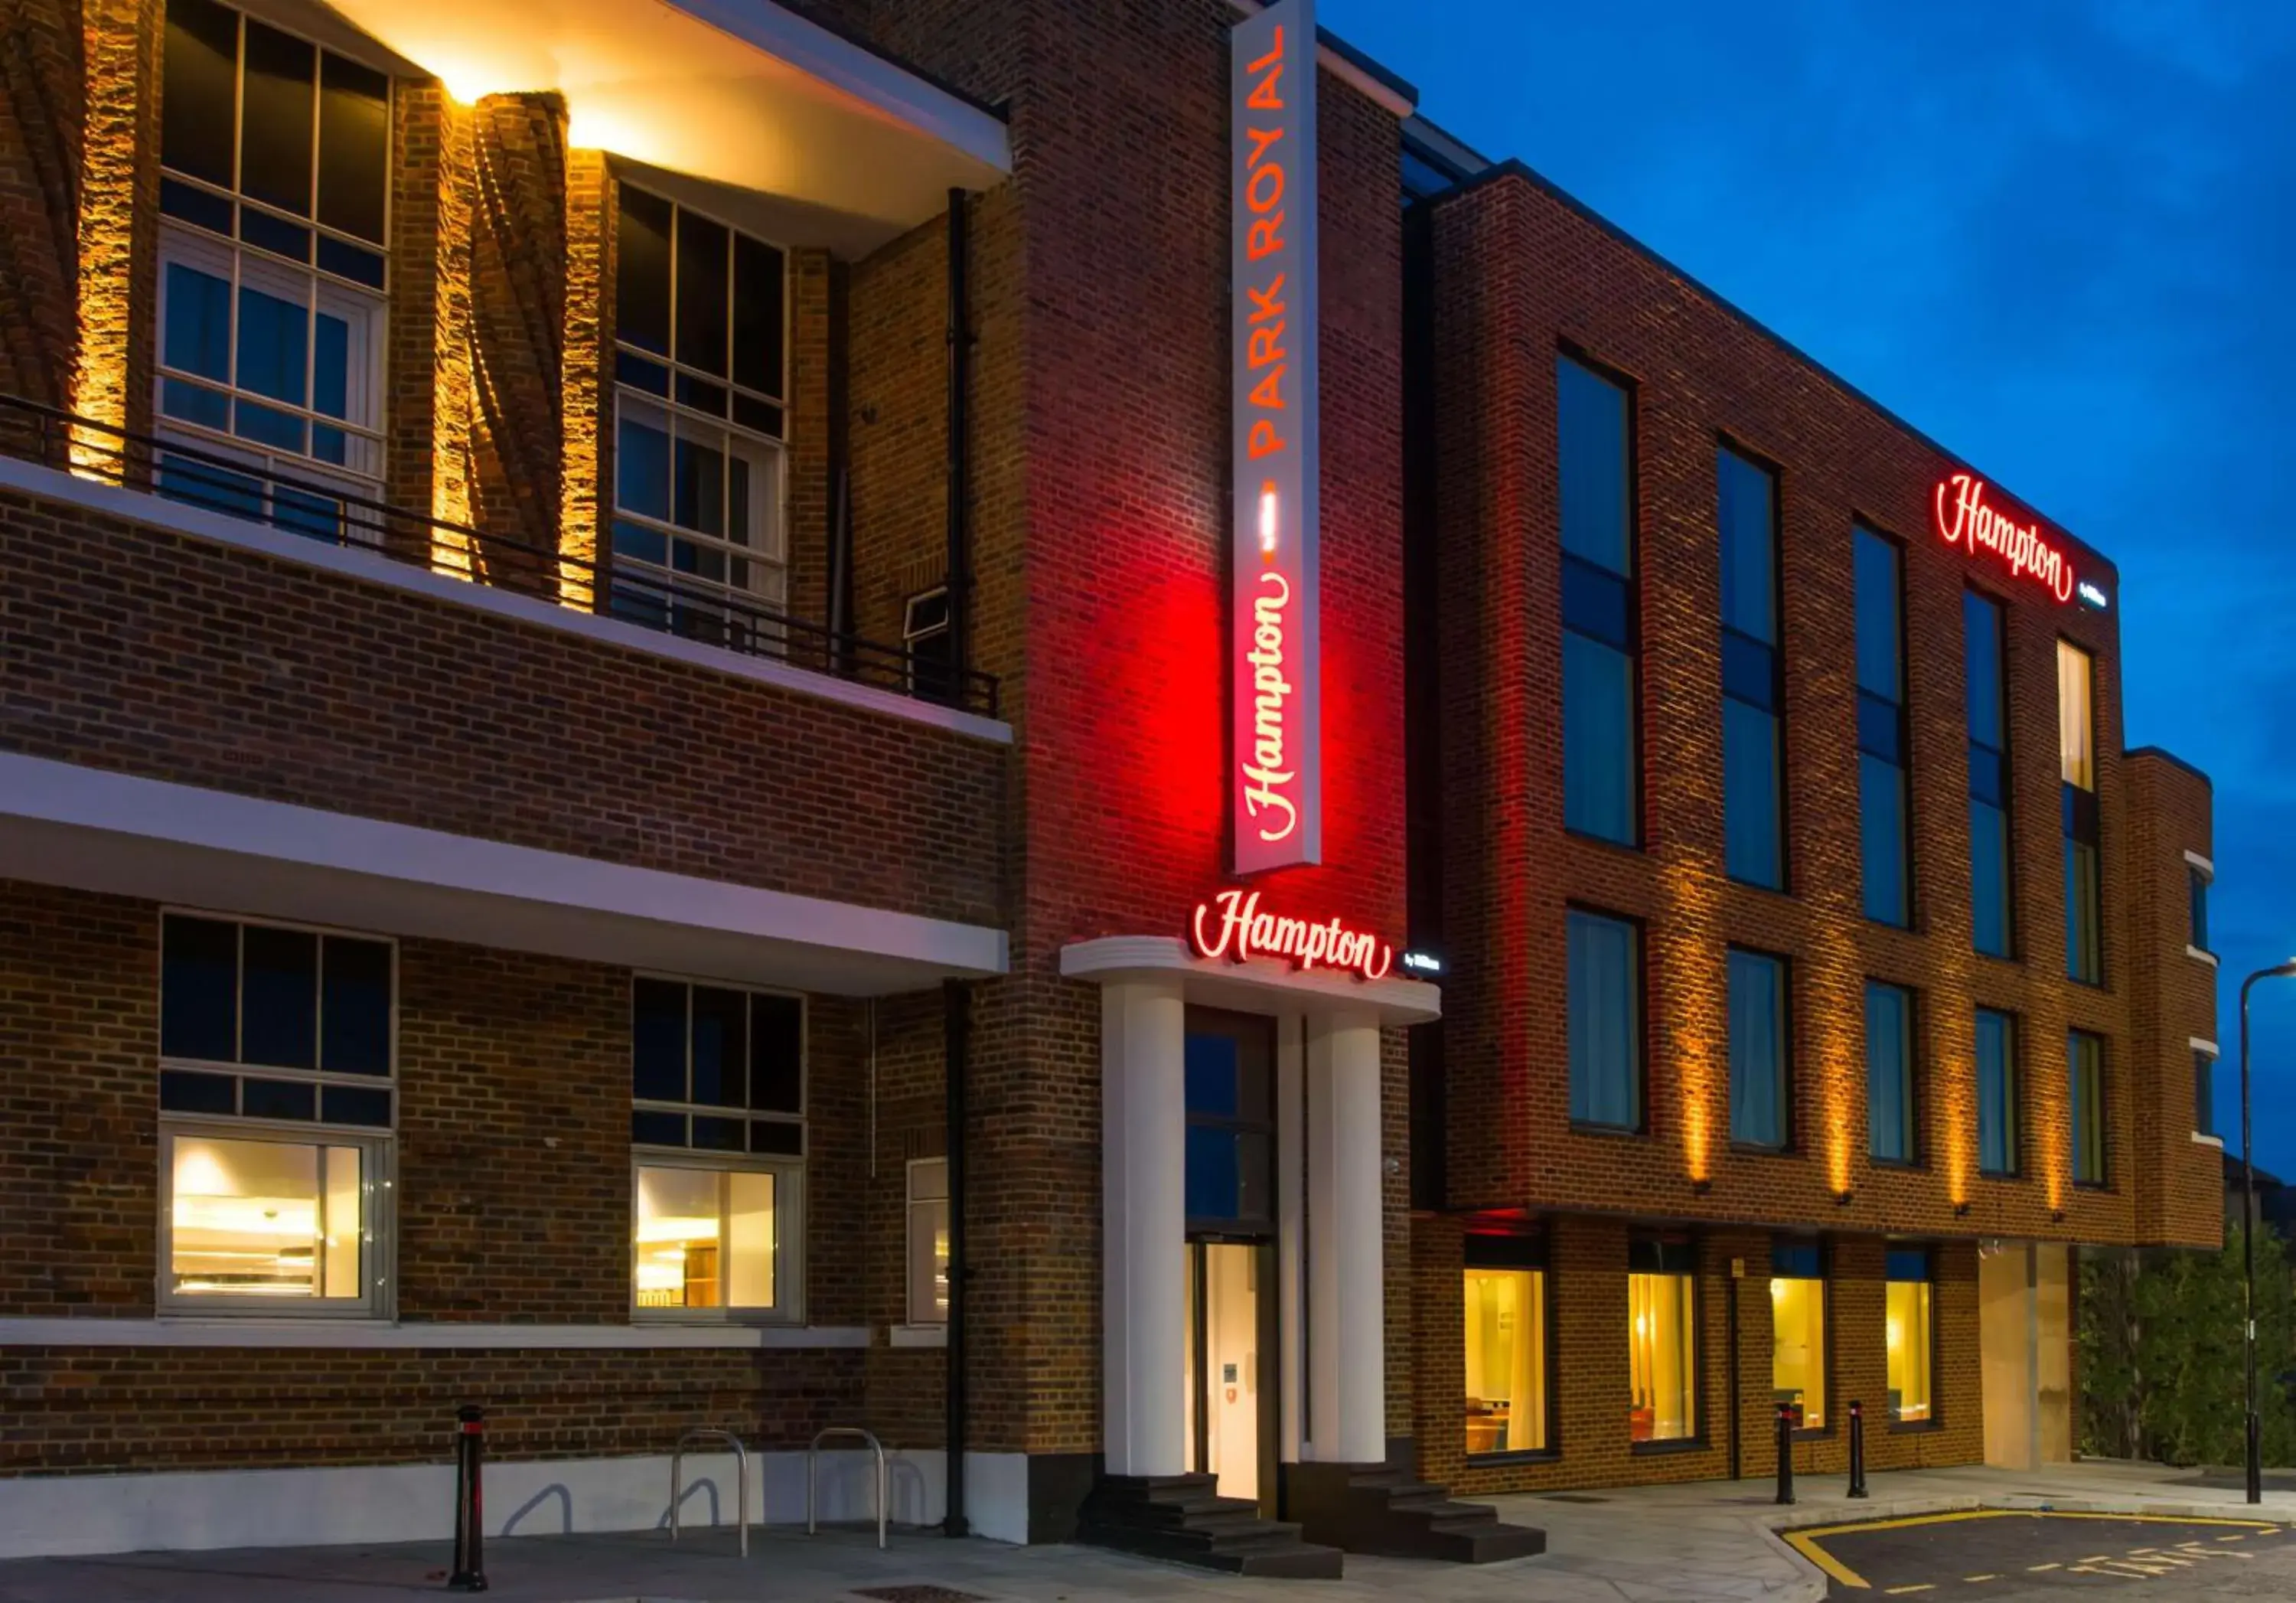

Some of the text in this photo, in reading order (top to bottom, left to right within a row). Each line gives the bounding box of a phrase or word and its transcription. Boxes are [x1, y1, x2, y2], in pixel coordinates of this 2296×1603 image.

[1246, 24, 1285, 261] ROYAL
[1247, 273, 1286, 459] PARK
[1937, 475, 2072, 601] Hampton
[1242, 572, 1296, 841] Hampton
[1195, 890, 1391, 979] Hampton
